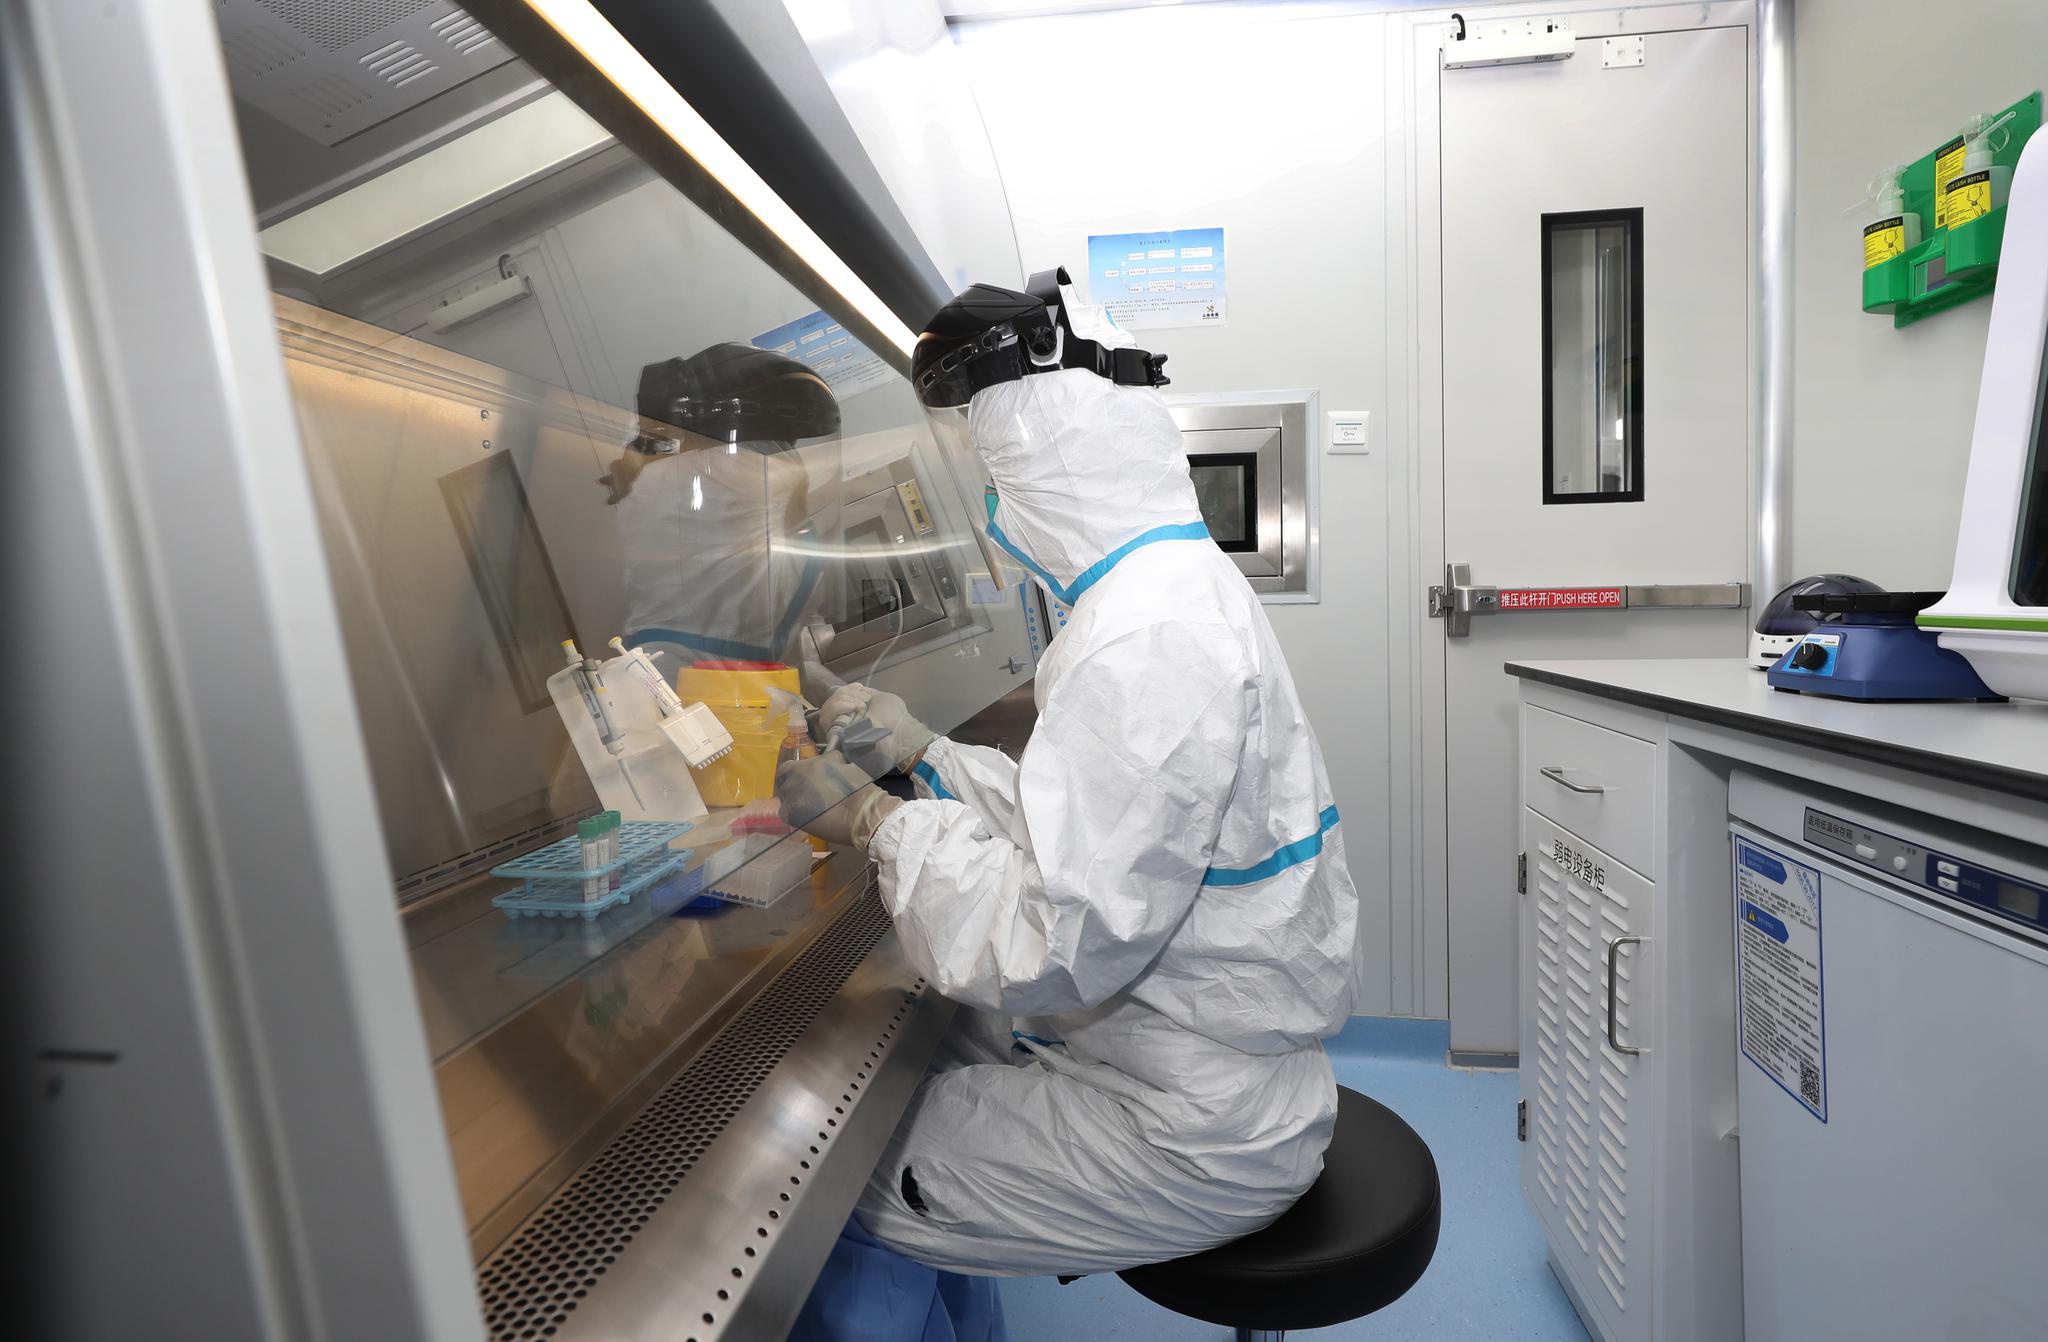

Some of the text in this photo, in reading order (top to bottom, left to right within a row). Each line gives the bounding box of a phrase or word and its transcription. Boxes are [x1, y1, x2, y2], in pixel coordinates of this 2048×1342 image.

[1967, 174, 1985, 184] BOTTLE
[1884, 219, 1899, 227] BOTTLE
[1501, 592, 1620, 607] 推压此杆开门 PUSH HERE OPEN
[1553, 839, 1605, 892] 弱电设备柜
